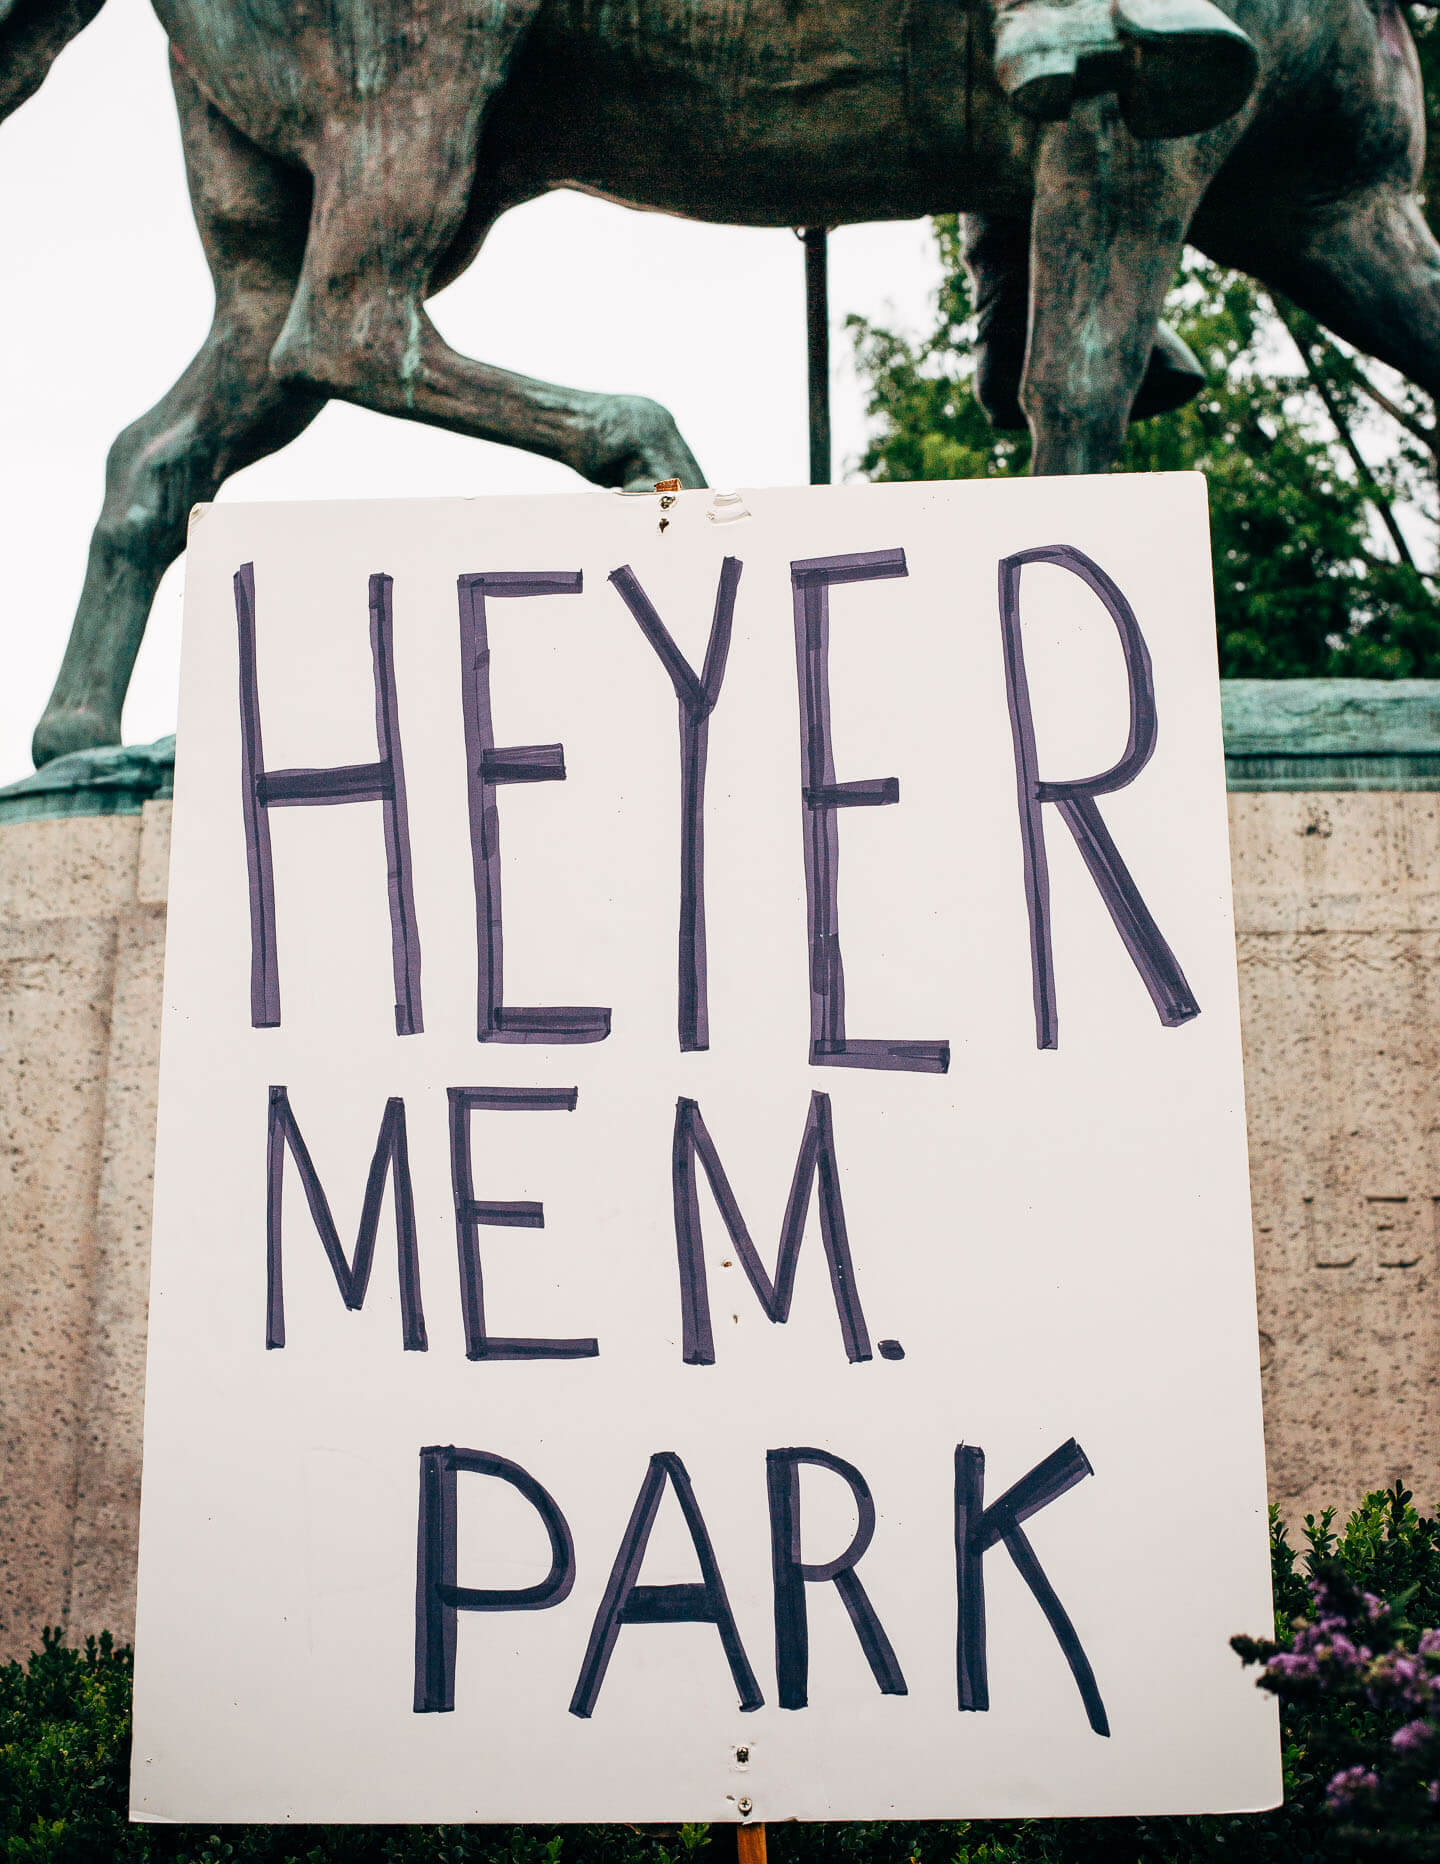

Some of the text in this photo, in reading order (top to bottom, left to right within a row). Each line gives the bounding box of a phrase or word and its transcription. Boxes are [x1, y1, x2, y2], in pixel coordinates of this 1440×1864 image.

[233, 545, 1202, 1075] HEYER
[266, 1086, 906, 1366] MEM.
[413, 1437, 1111, 1739] PARK
